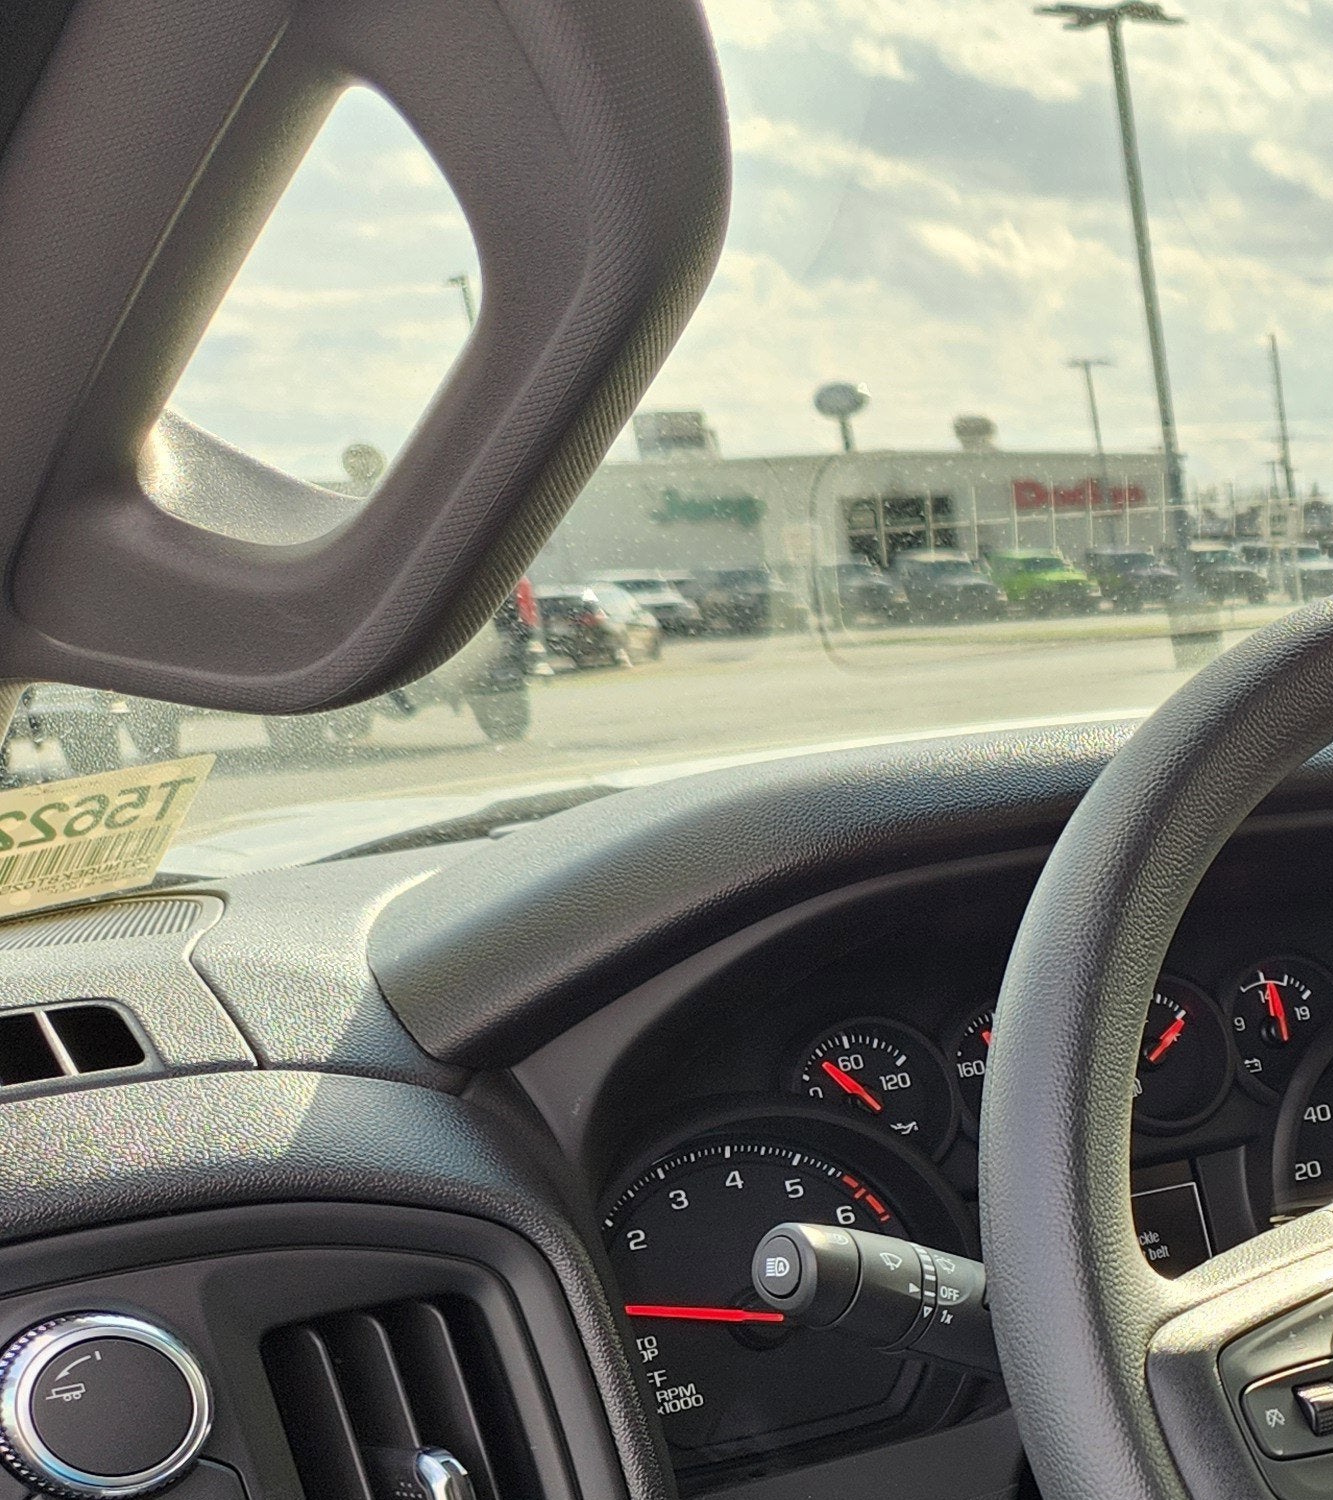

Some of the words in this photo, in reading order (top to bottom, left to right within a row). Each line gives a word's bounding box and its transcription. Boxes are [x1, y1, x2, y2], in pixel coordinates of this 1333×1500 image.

[1294, 1006, 1310, 1021] 19
[1234, 1017, 1245, 1031] 9
[837, 1054, 864, 1072] 60
[957, 1059, 985, 1078] 160
[879, 1072, 911, 1090] 120
[1304, 1104, 1331, 1123] 40
[725, 1170, 744, 1190] 4
[1295, 1161, 1321, 1181] 20
[785, 1178, 804, 1199] 5
[668, 1189, 689, 1210] 3
[836, 1205, 856, 1225] 6
[626, 1229, 647, 1251] 2
[1148, 1245, 1170, 1260] belt
[940, 1285, 960, 1301] OFF
[940, 1309, 953, 1325] 1x
[656, 1383, 697, 1403] RPM
